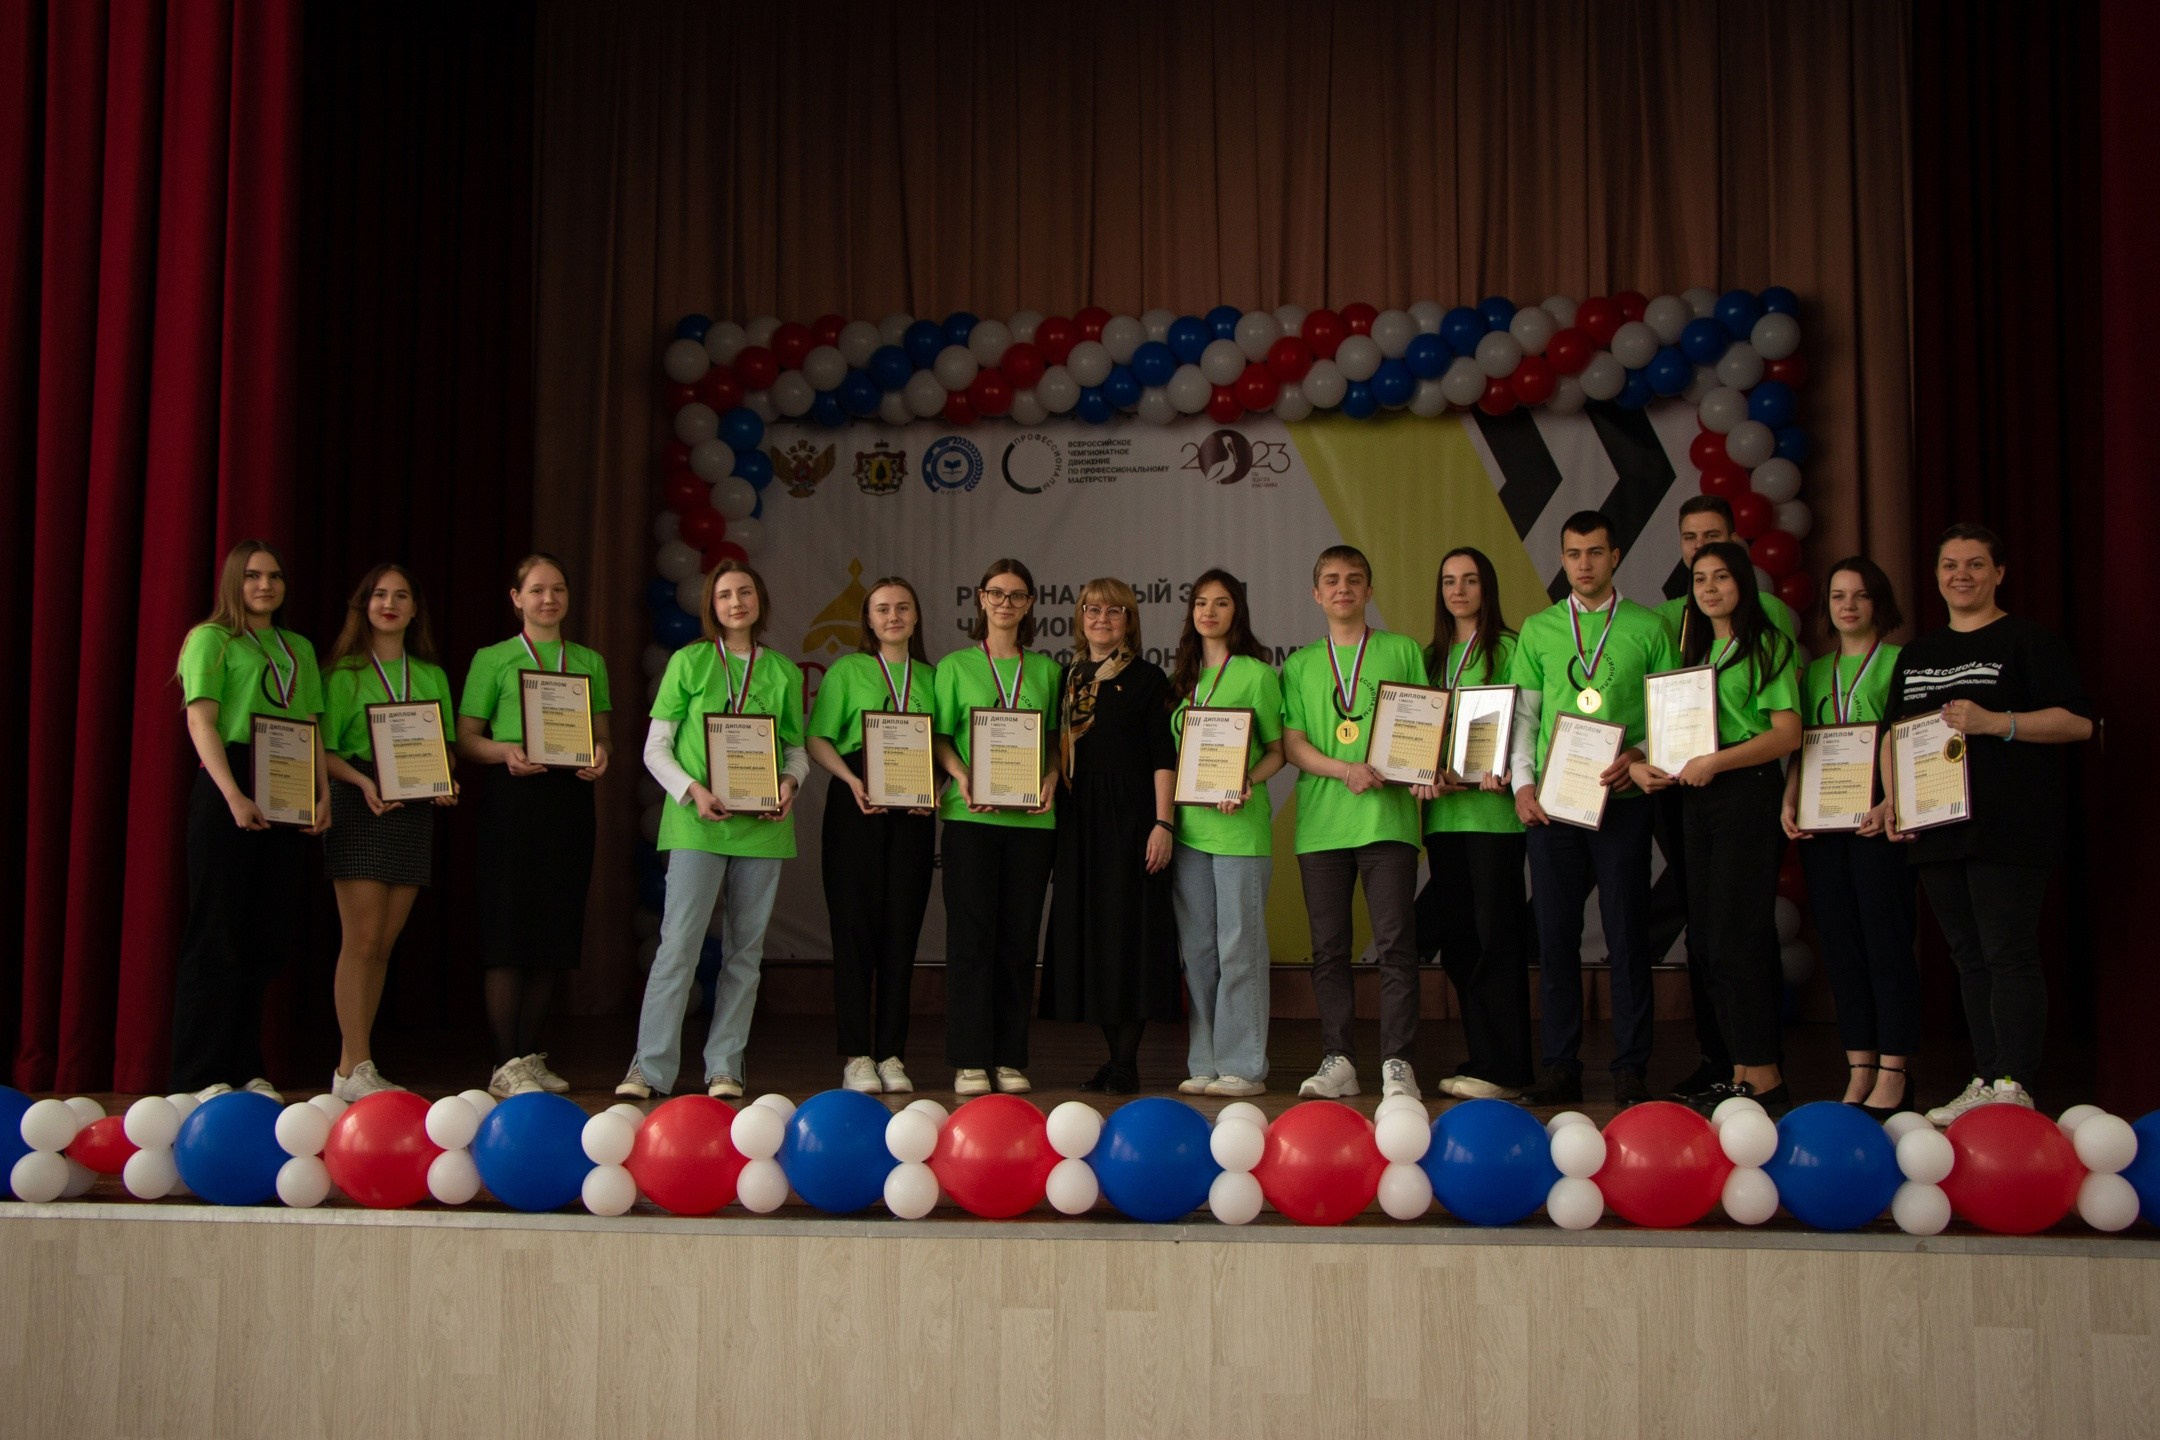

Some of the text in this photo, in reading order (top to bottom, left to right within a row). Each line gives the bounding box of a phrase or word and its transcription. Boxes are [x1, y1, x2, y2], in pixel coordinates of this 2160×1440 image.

[1068, 439, 1132, 447] ВСЕРОССИЙСКОЕ
[1068, 448, 1129, 456] ЧЕМПИОНАТНОЕ
[1013, 434, 1062, 491] ПРОФЕССИОНАЛЫ
[1068, 457, 1111, 466] ДВИЖЕНИЕ
[1068, 465, 1169, 475] ПО ПРОФЕССИОНАЛЬНОМУ
[1068, 475, 1117, 484] МАСТЕРСТВУ
[1399, 692, 1427, 700] ДИПЛОМ
[1912, 719, 1940, 731] ДИПЛОМ
[1823, 731, 1854, 739] ДИПЛОМ
